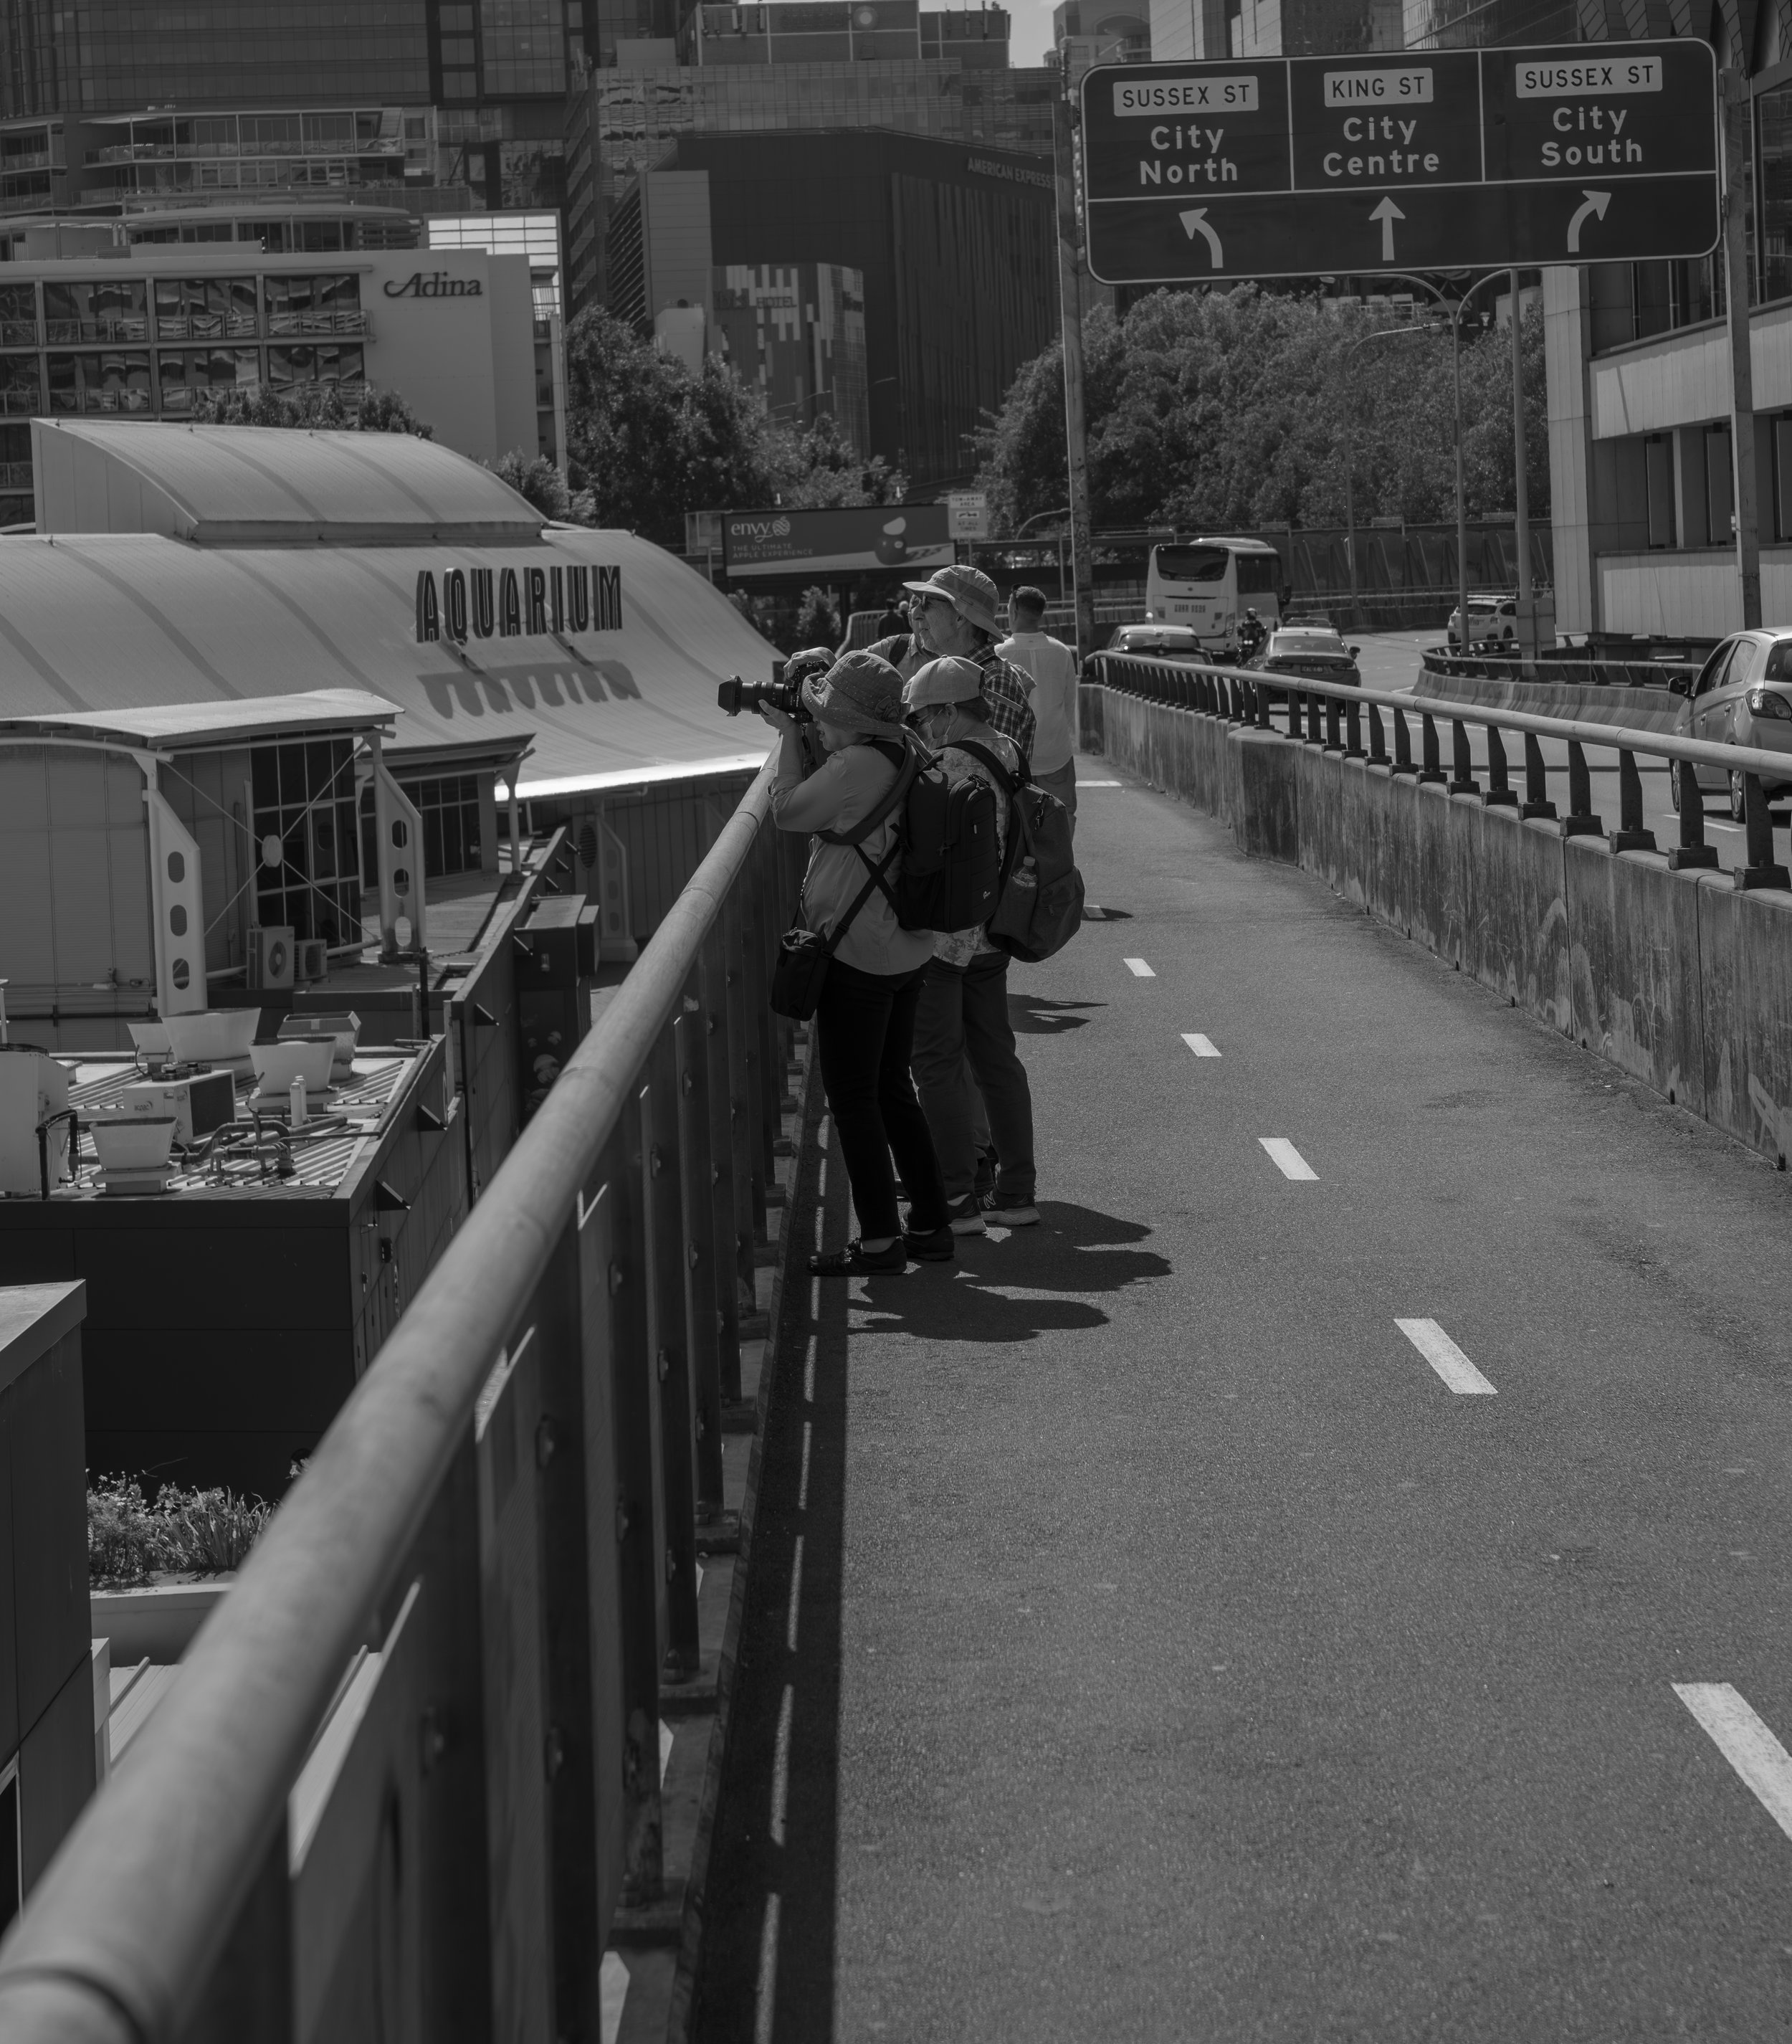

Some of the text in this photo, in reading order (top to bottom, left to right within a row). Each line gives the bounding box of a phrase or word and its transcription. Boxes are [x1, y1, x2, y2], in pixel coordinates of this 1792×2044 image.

[1332, 76, 1426, 99] KING ST
[1525, 65, 1654, 90] SUSSEX ST
[1123, 84, 1251, 108] SUSSEX ST
[1343, 115, 1417, 145] City
[1553, 105, 1628, 135] City
[1150, 124, 1224, 153] City
[1322, 148, 1440, 177] Centre
[1540, 138, 1643, 167] South
[968, 157, 1052, 189] AMERICAN EXPRESS
[1140, 157, 1239, 185] North
[383, 271, 483, 298] Adina
[756, 295, 797, 309] HOTEL
[730, 522, 773, 543] envy
[750, 543, 792, 551] ULTIMATE
[762, 548, 814, 558] EXPERIENCE
[416, 565, 622, 646] AQUARIUM
